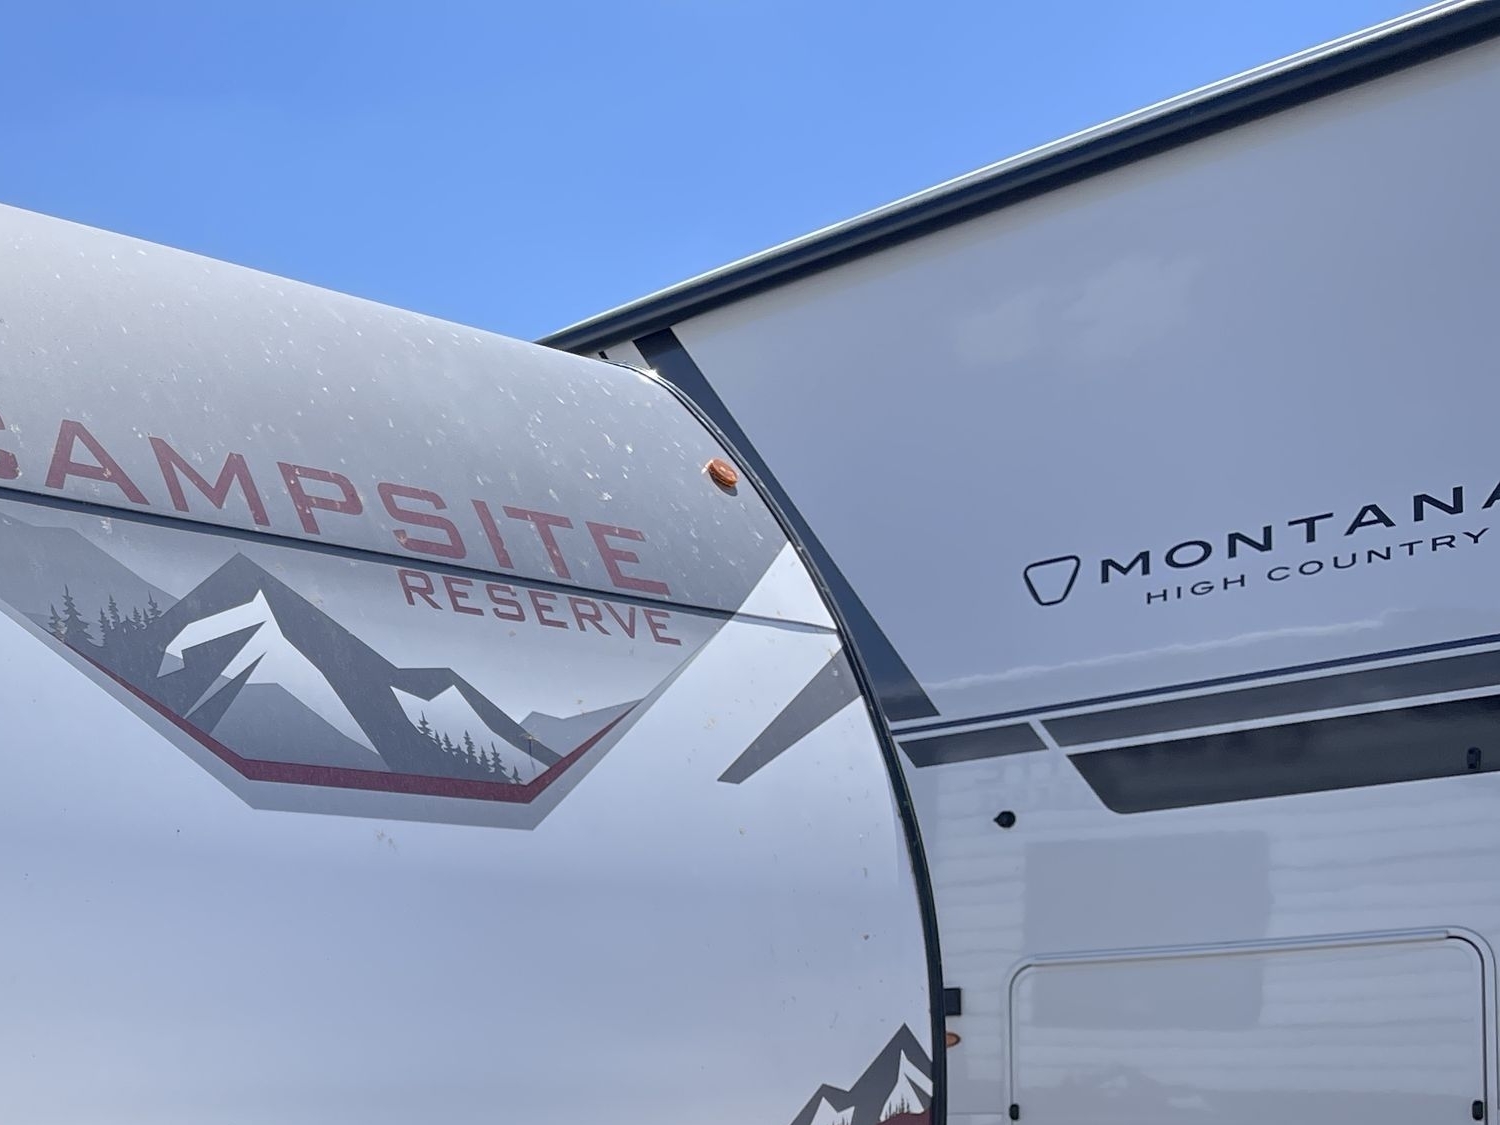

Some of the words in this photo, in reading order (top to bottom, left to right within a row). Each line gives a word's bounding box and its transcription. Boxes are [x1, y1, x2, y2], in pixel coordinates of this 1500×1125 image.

[1146, 574, 1246, 604] HIGH
[1267, 527, 1490, 582] COUNTRY
[398, 569, 682, 647] RESERVE
